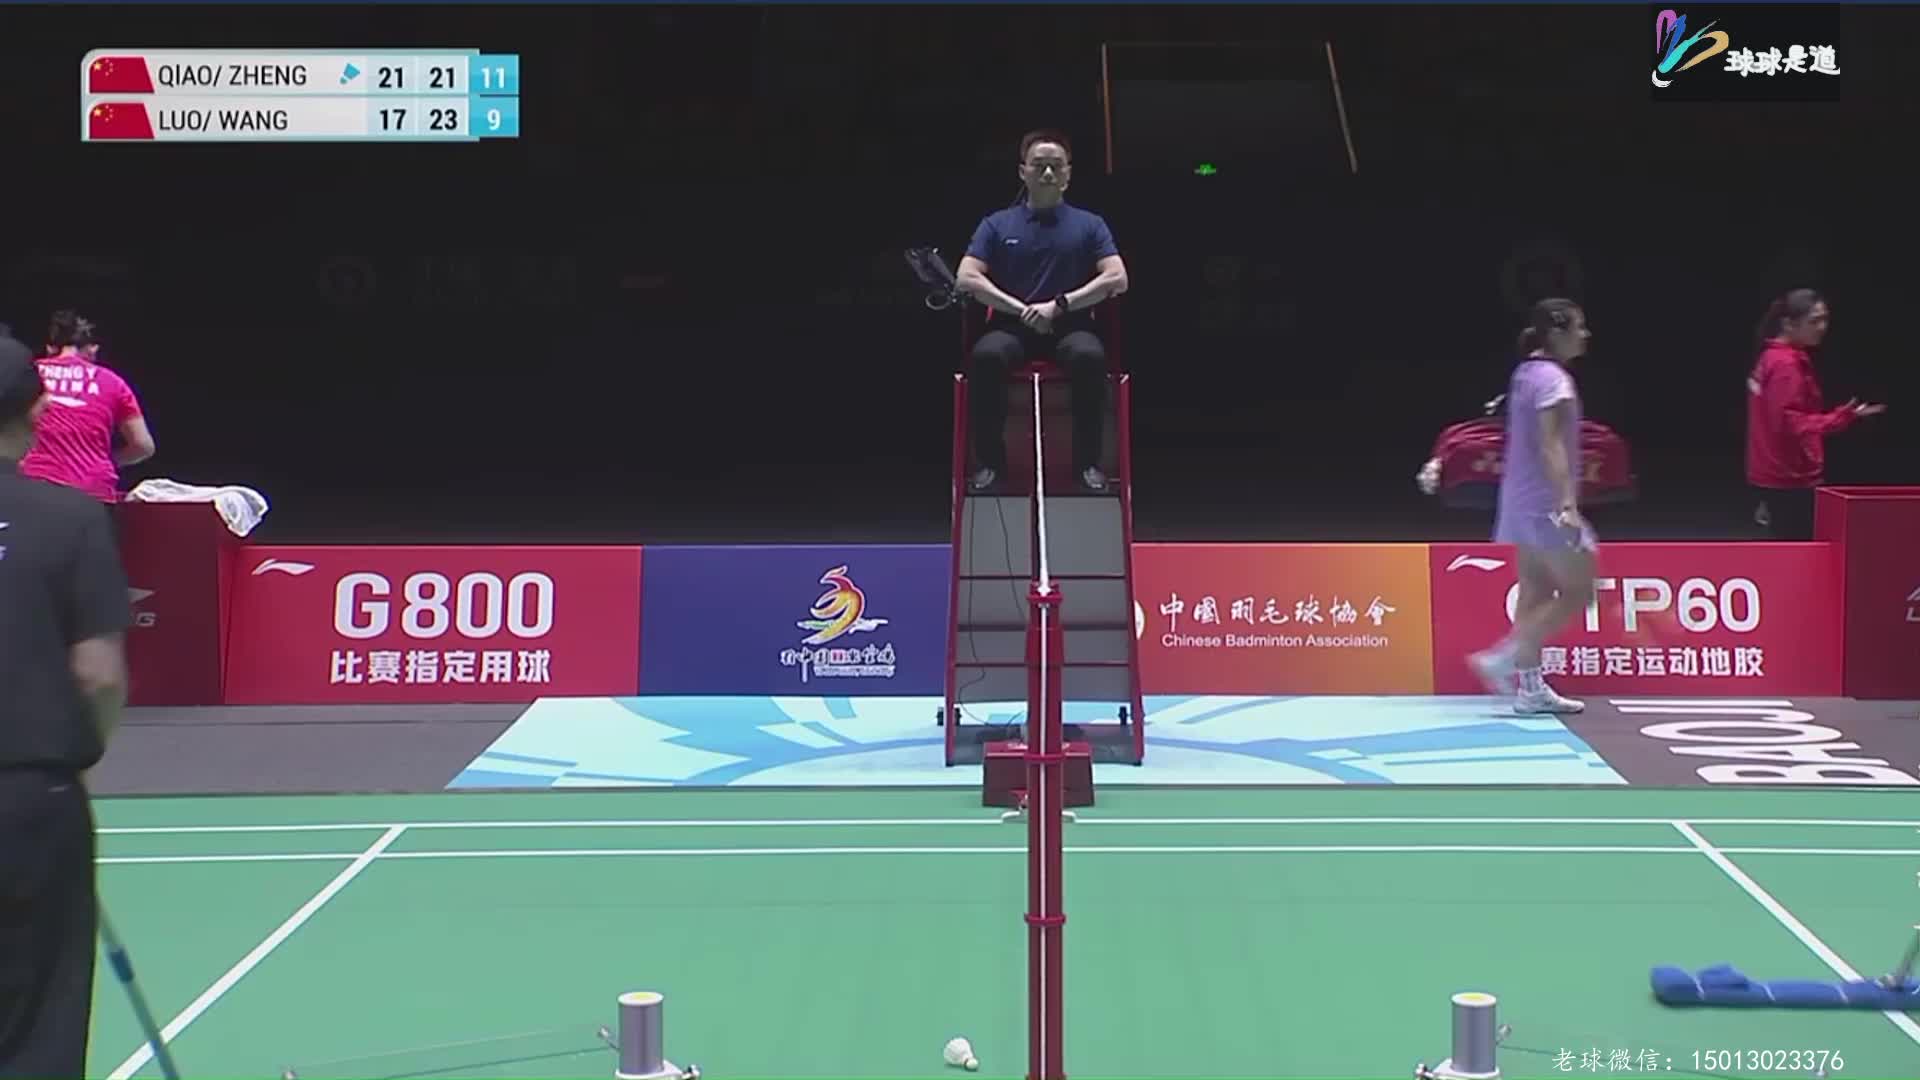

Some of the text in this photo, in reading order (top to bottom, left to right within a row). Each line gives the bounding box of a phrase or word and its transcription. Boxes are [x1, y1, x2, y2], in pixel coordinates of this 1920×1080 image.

[333, 571, 555, 639] G800
[1505, 577, 1761, 633] TP60
[1161, 634, 1389, 648] Chinese Badminton Association
[329, 650, 551, 684] 比赛指定用球
[1539, 646, 1765, 677] 赛指定运动地胶
